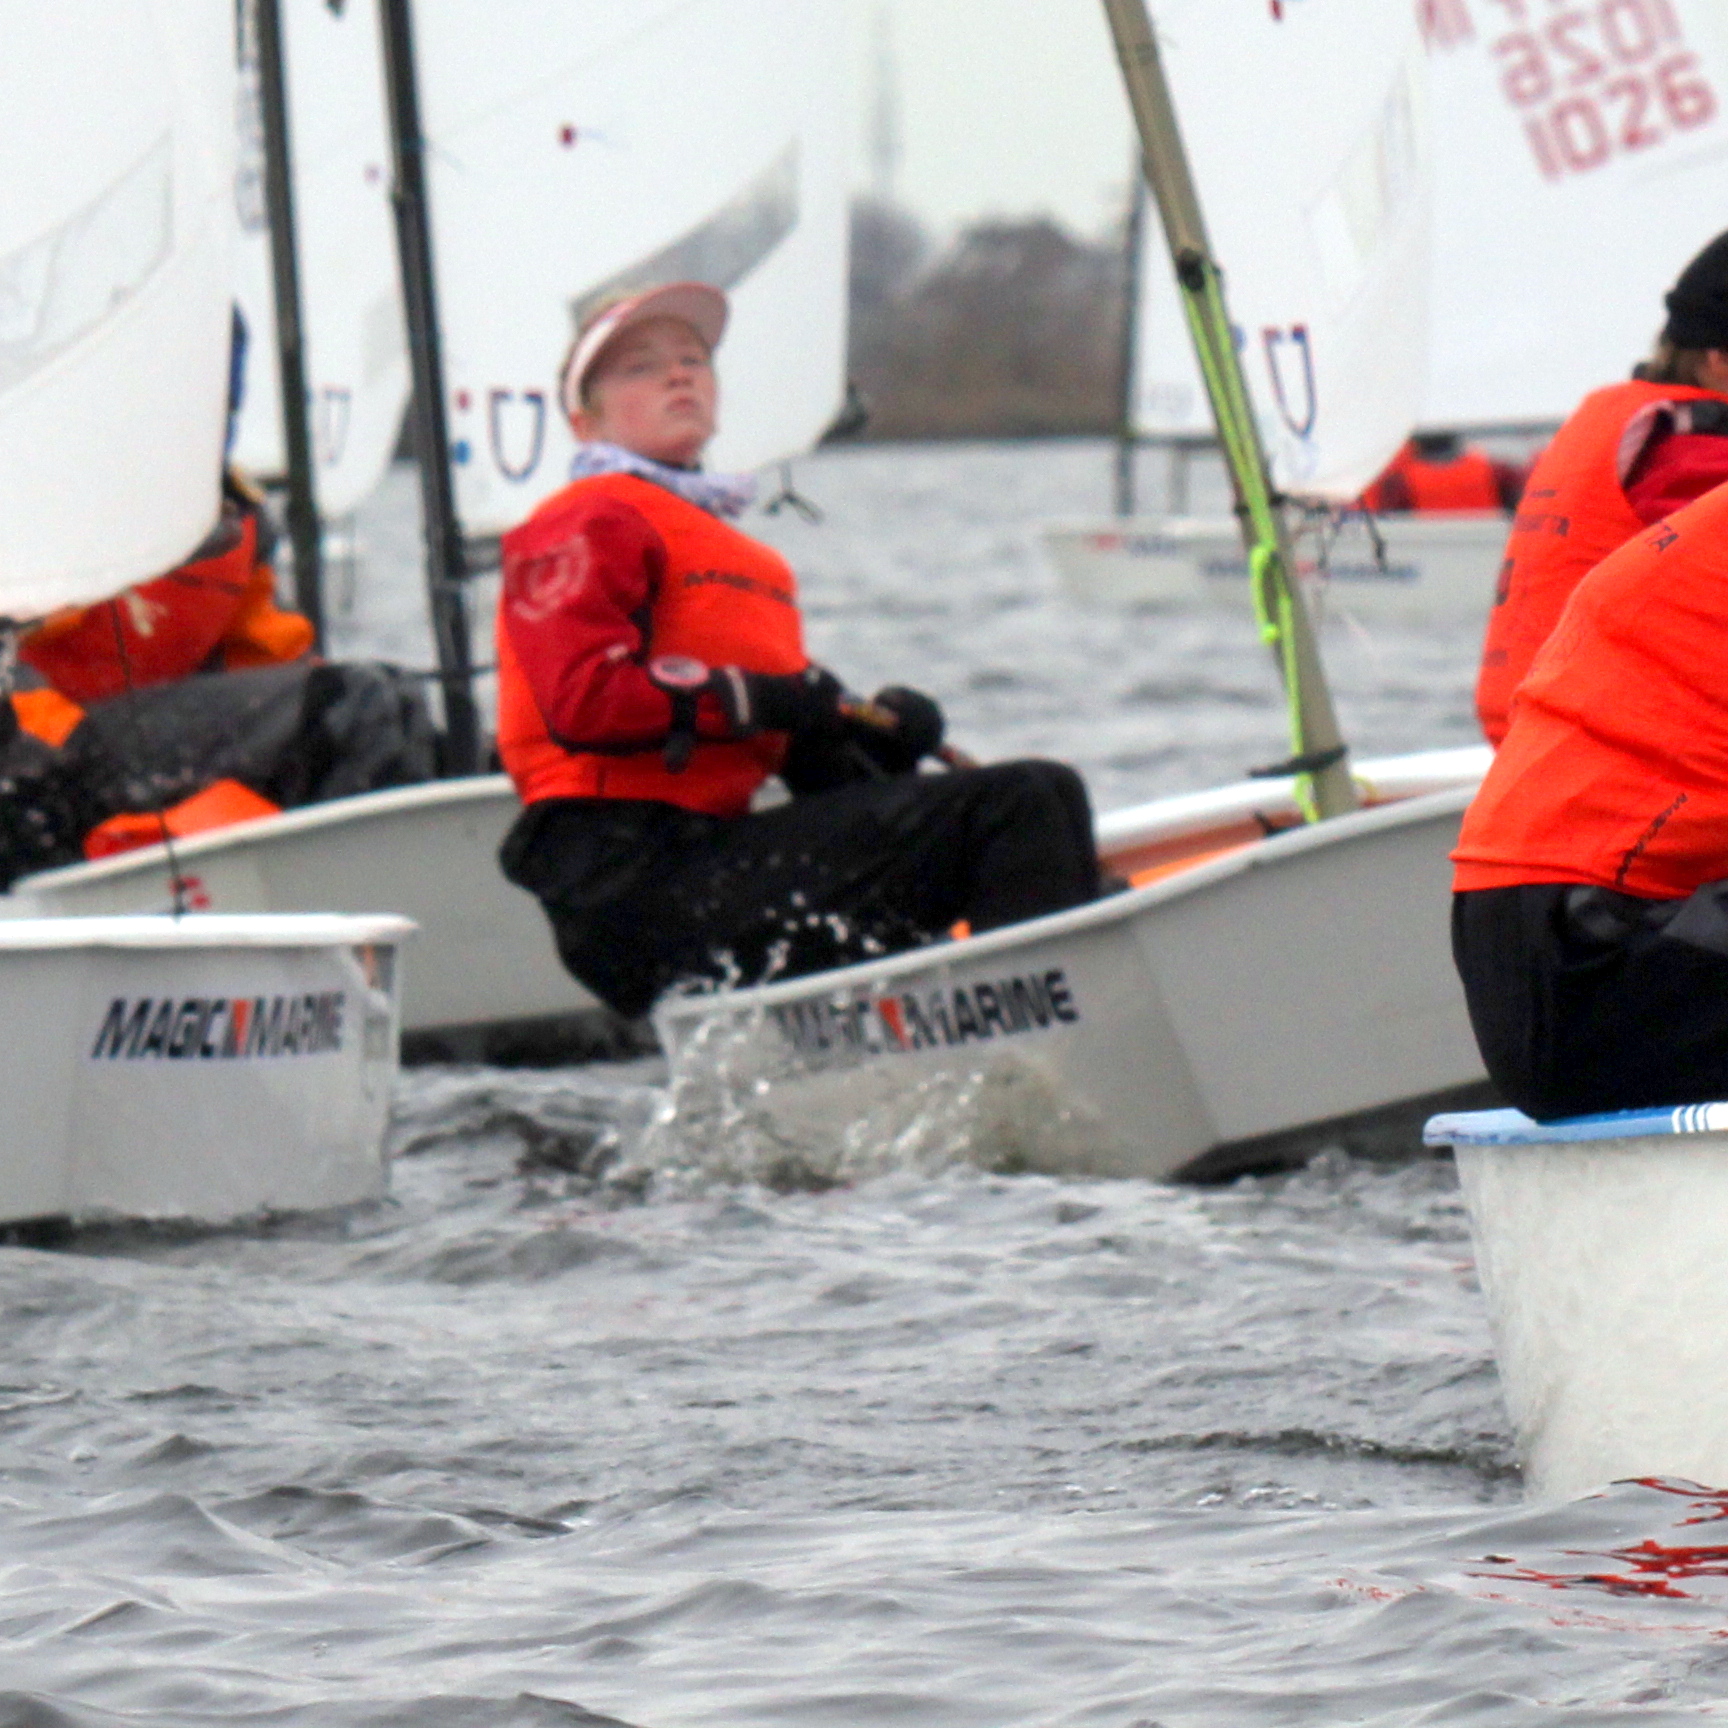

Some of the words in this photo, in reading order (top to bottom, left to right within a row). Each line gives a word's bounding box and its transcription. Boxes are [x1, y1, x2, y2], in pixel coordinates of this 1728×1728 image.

[1526, 49, 1717, 181] 1026
[94, 997, 223, 1060] MAGIC
[246, 991, 345, 1057] MARINE
[907, 969, 1077, 1051] MARINE
